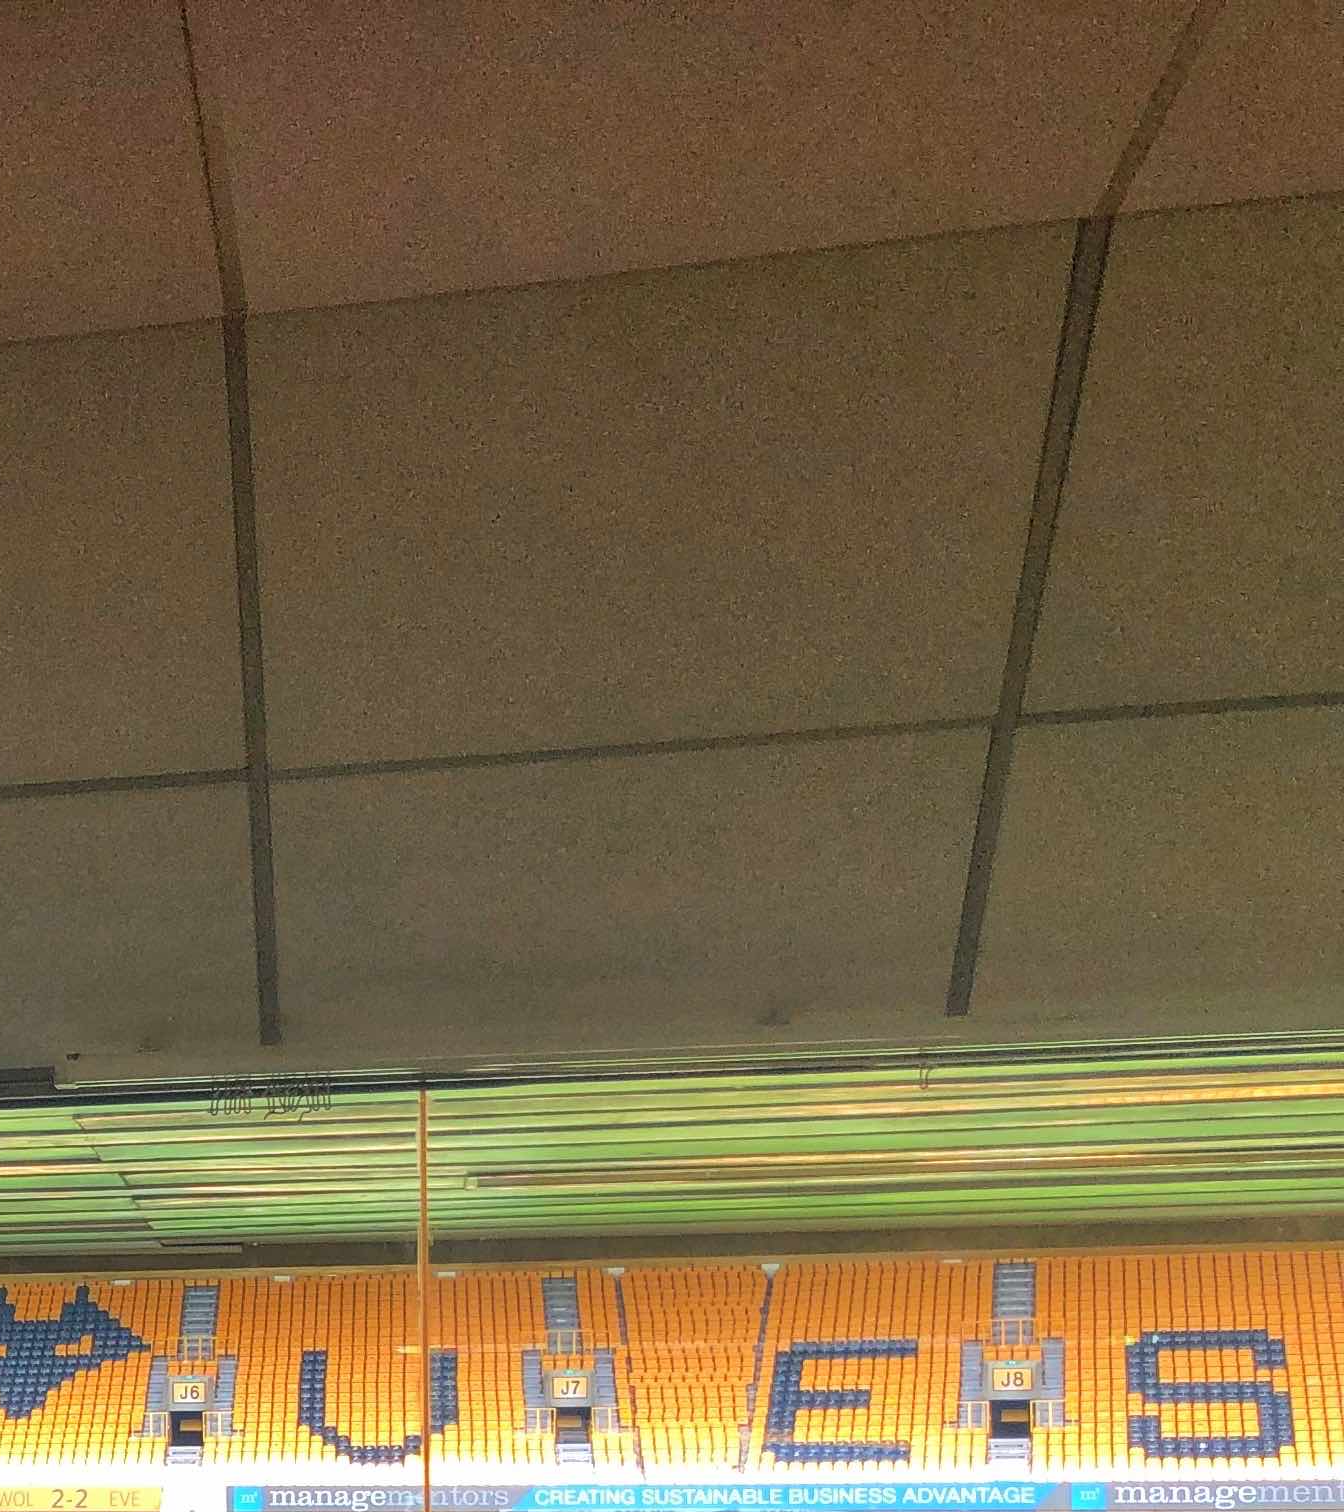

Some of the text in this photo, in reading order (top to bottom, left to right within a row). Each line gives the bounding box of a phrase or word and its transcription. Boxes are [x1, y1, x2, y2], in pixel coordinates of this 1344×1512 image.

[561, 1378, 580, 1397] J7
[1002, 1370, 1024, 1389] J8
[180, 1384, 200, 1402] J6
[51, 1489, 88, 1508] 2-2
[109, 1491, 140, 1507] EVE
[534, 1487, 1035, 1504] CREATING SUSTAINABLE BUSINESS ADVANTAGE
